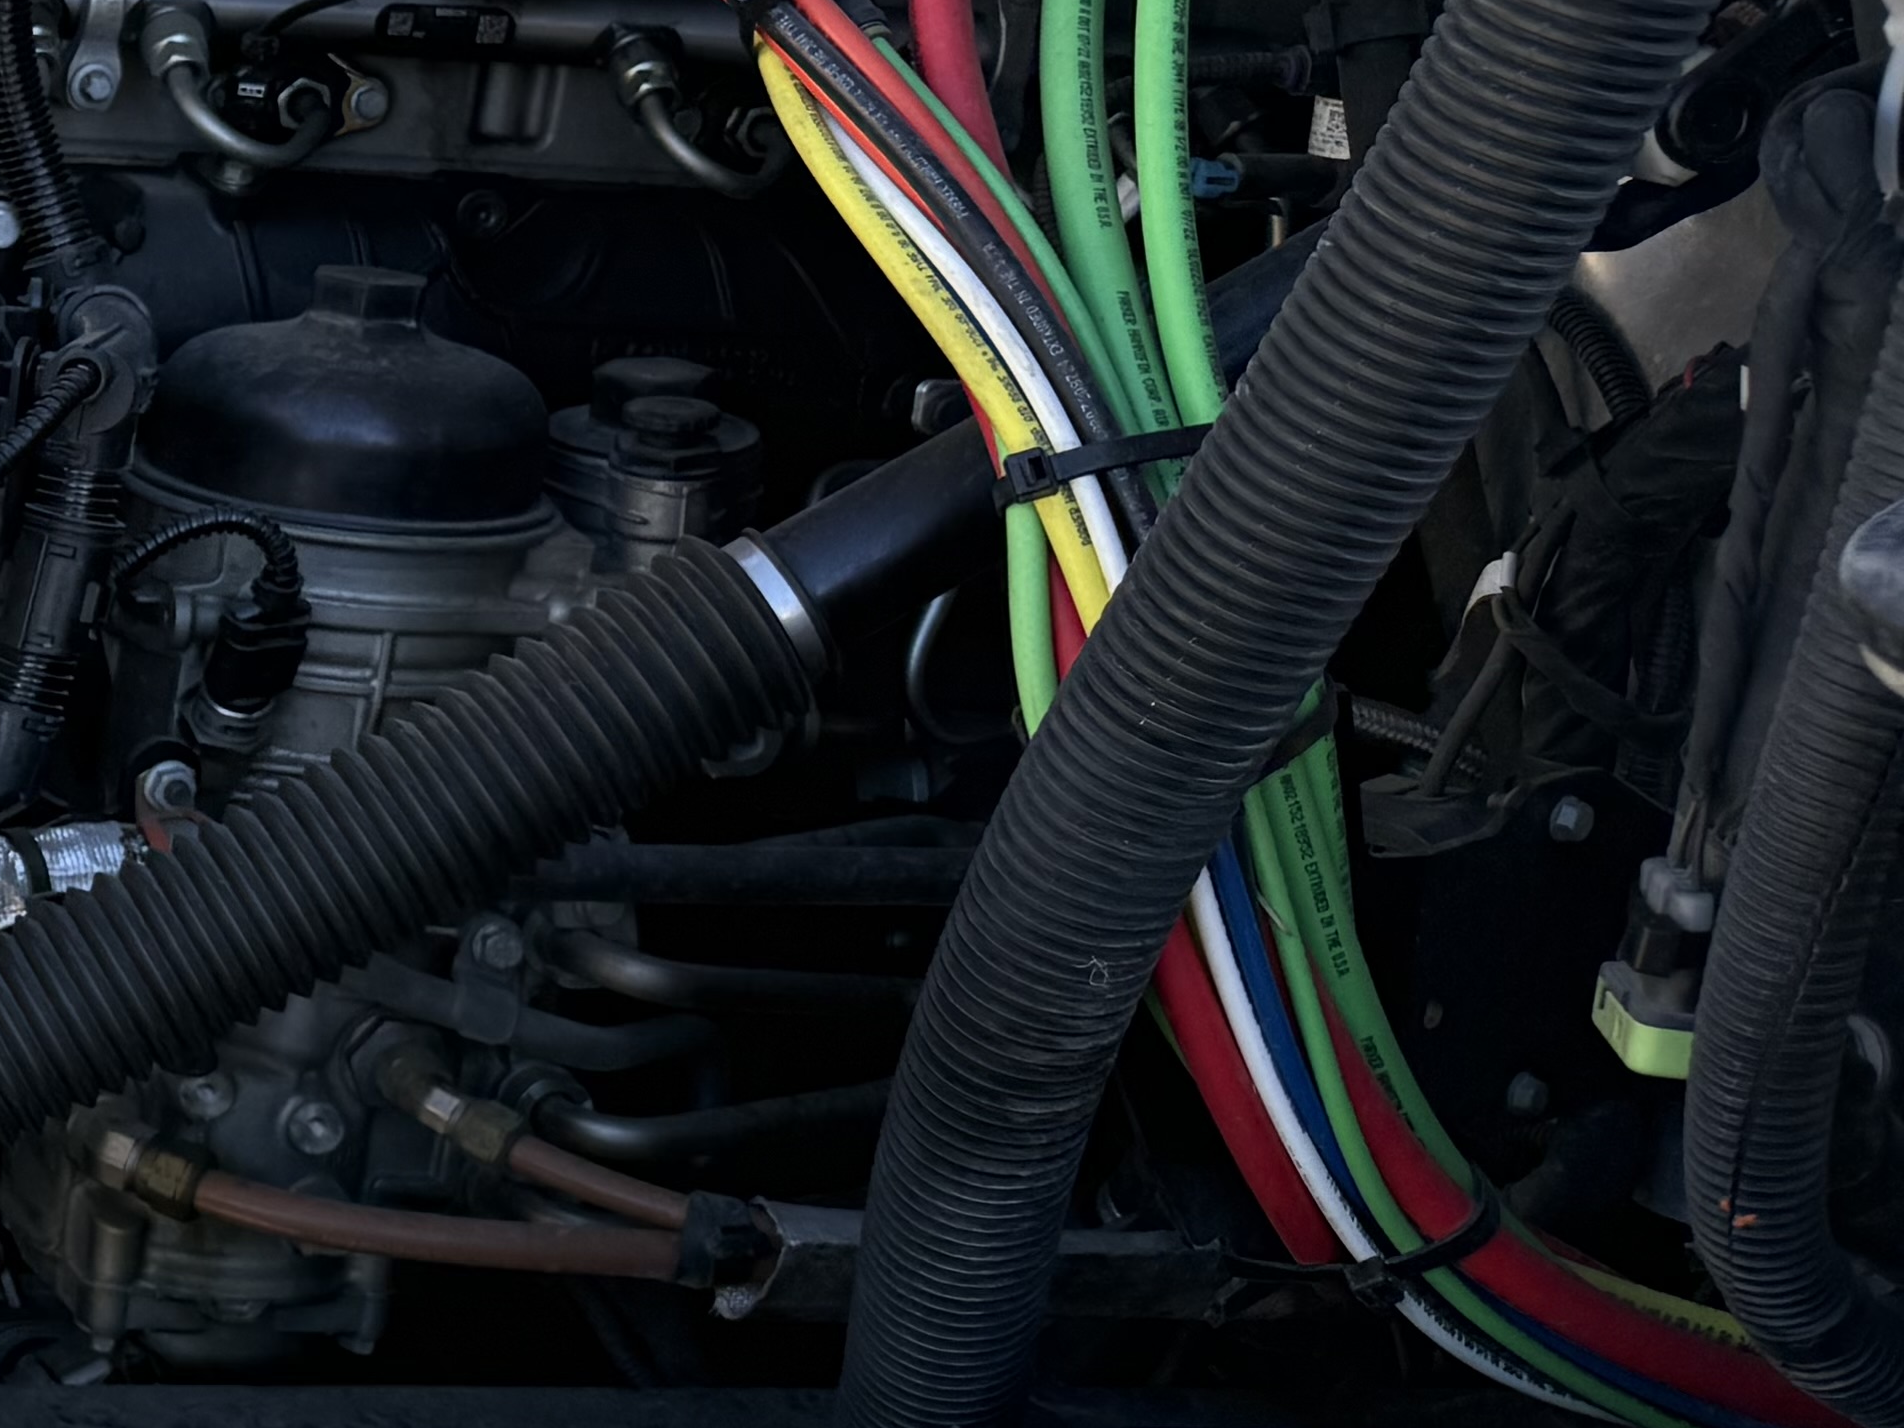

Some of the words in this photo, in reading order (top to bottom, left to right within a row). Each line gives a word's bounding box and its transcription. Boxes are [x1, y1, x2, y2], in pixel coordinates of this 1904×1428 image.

[1089, 186, 1105, 205] THE
[1015, 287, 1034, 305] IN
[1116, 288, 1138, 327] PARKER
[1303, 860, 1331, 913] EXTRUDED
[1318, 914, 1336, 929] IN
[1323, 929, 1343, 951] THE
